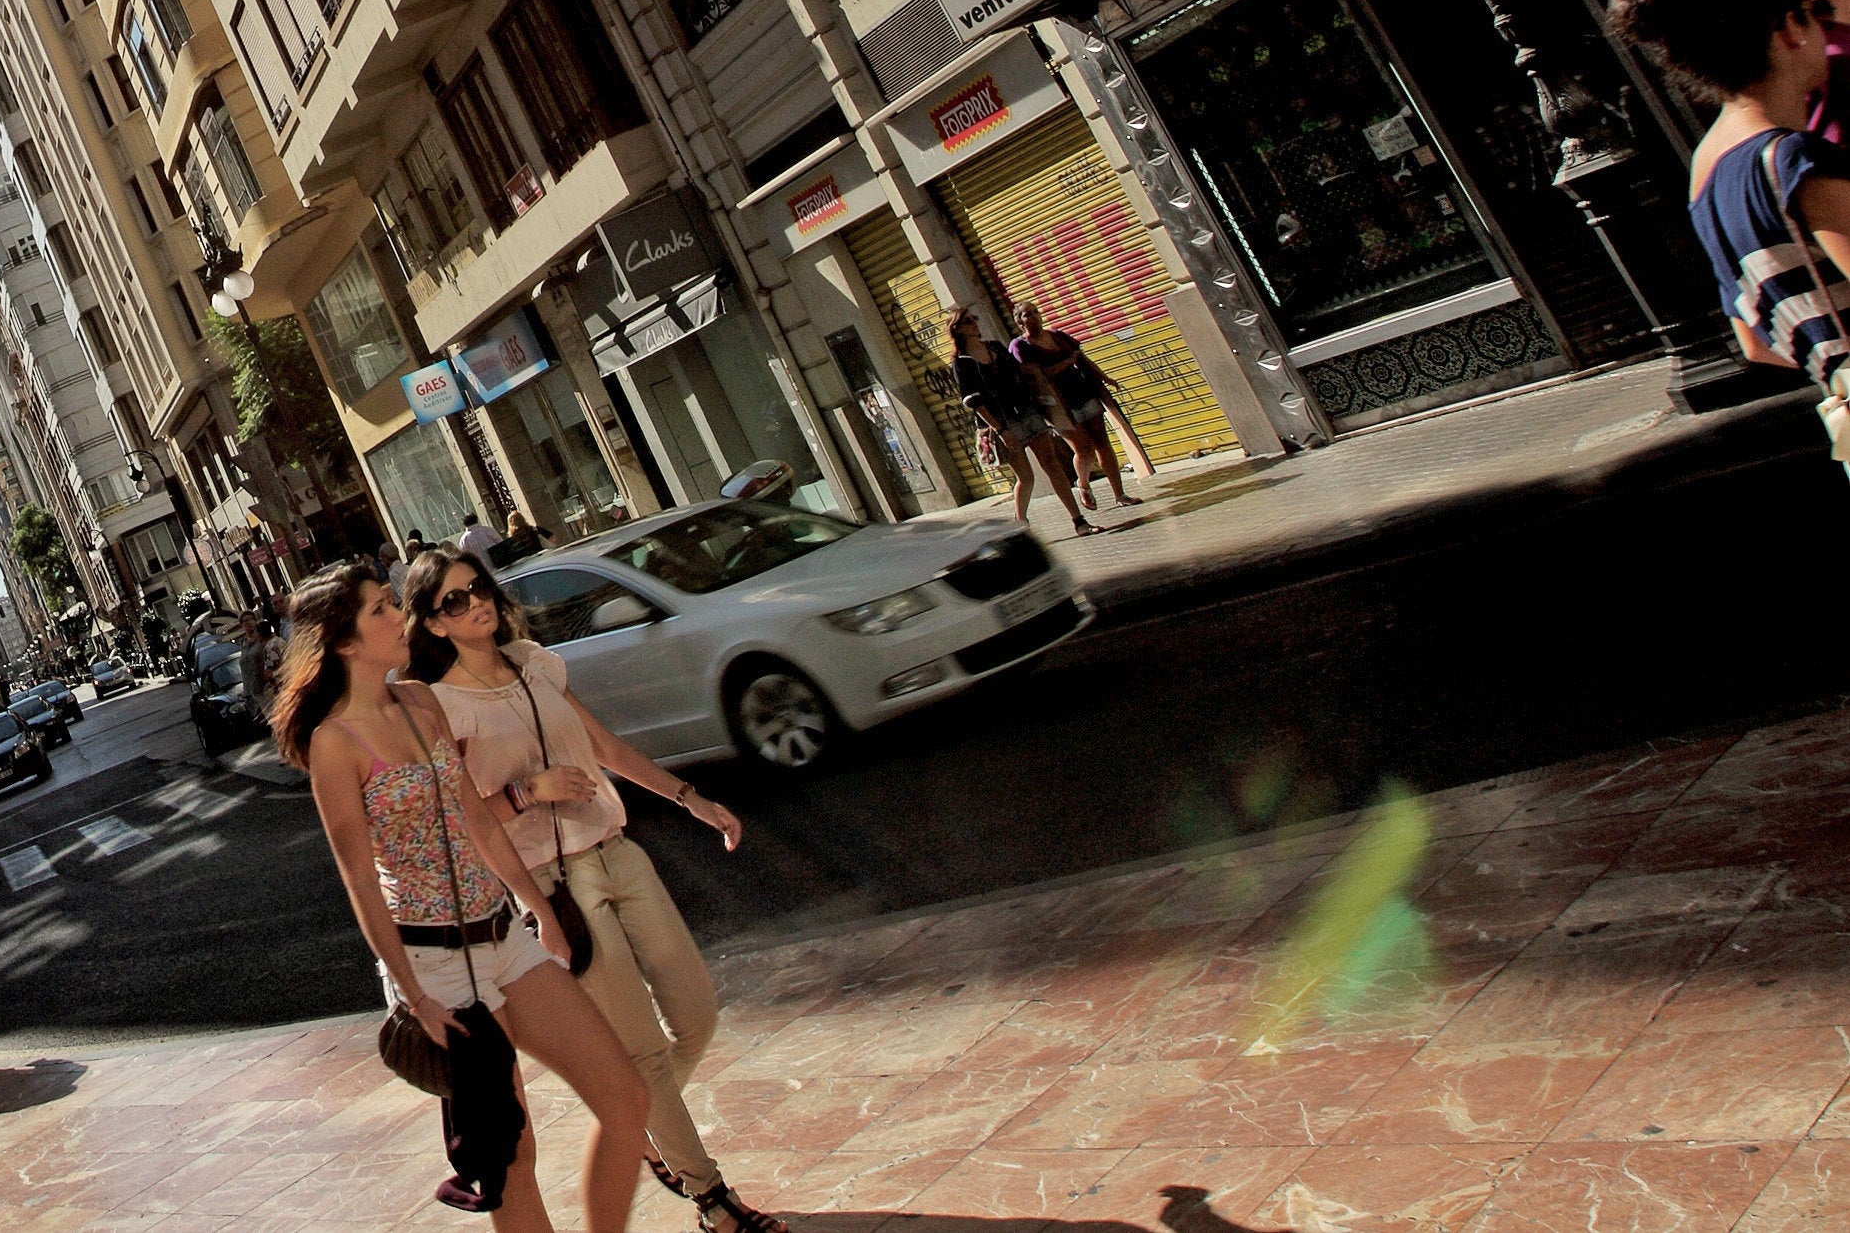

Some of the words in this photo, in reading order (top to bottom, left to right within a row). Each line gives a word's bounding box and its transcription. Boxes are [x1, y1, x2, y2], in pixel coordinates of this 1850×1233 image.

[938, 86, 1000, 141] FOTOPRIX
[793, 183, 841, 227] FOTOPRIX
[624, 229, 695, 273] Clarks
[645, 320, 674, 353] Clarks
[415, 375, 447, 397] GAES
